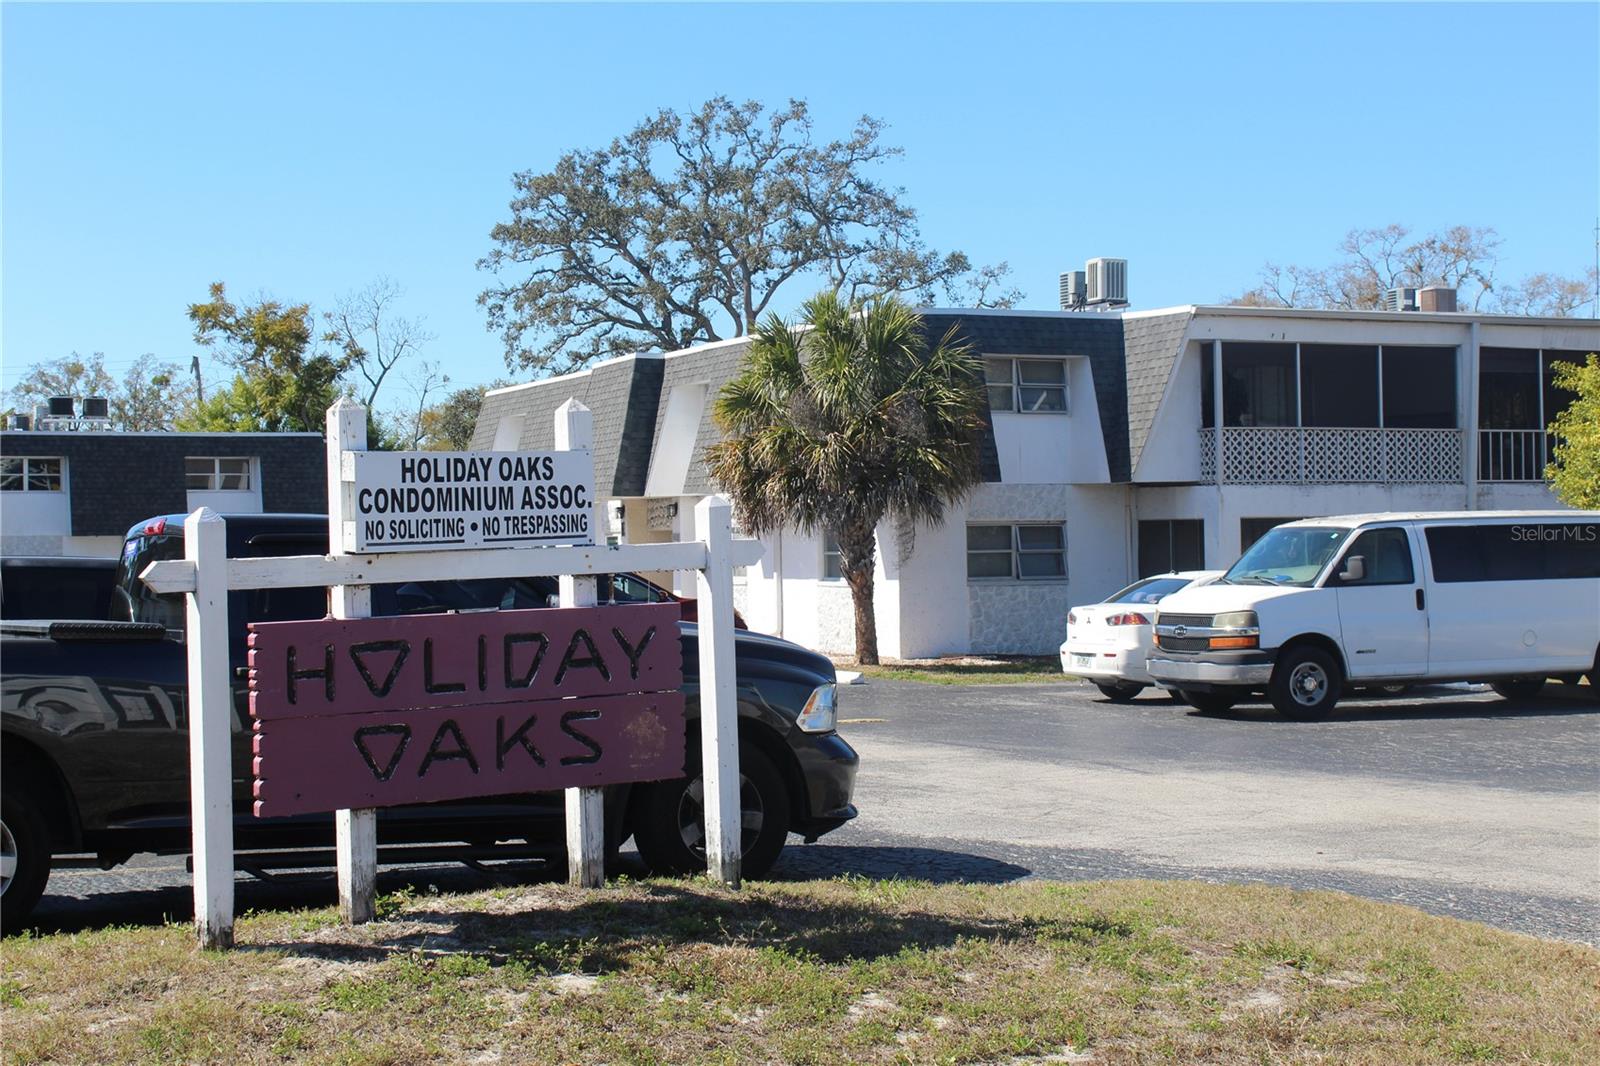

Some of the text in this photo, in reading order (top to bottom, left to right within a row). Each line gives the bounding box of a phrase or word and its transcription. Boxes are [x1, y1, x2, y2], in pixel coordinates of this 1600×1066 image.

[402, 456, 553, 482] HOLIDAY OAKS
[359, 485, 592, 513] CONDOMINIUM ASSOC.
[365, 514, 587, 540] NO SOLICITING NO TRESPASSING
[287, 626, 656, 705] HOLIDAY
[353, 710, 603, 782] OAKS
